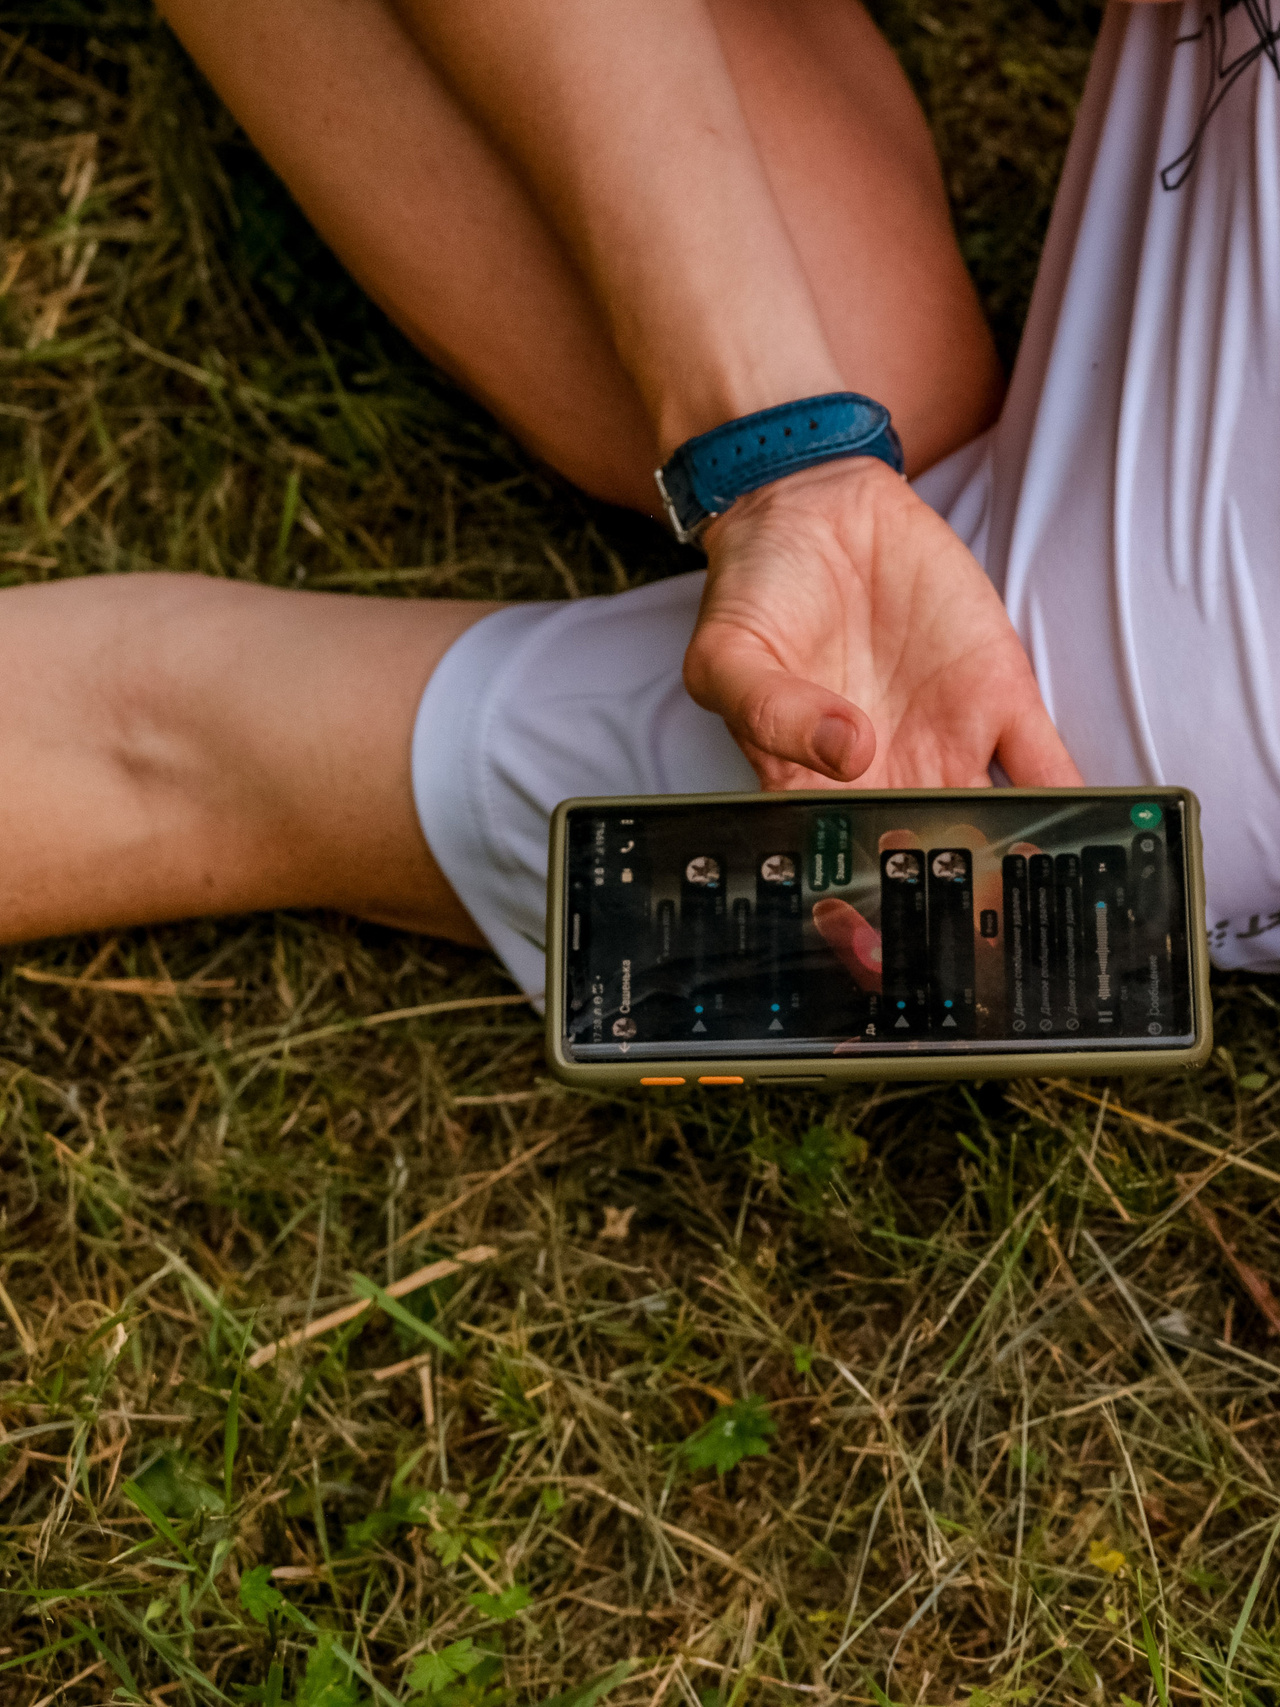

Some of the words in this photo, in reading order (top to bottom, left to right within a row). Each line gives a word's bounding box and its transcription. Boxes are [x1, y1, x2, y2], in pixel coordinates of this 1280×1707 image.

[1010, 887, 1022, 926] удалено
[1037, 887, 1049, 925] удалено
[1063, 887, 1075, 925] удалено
[1012, 927, 1024, 979] сообщение
[1038, 927, 1050, 979] сообщение
[1064, 927, 1076, 978] сообщение
[619, 959, 632, 1014] Сашенька
[1014, 980, 1025, 1016] Данное
[1040, 980, 1051, 1015] Данное
[1066, 980, 1077, 1015] Данное
[1149, 954, 1162, 1016] Сообщение
[866, 1023, 876, 1036] Да
